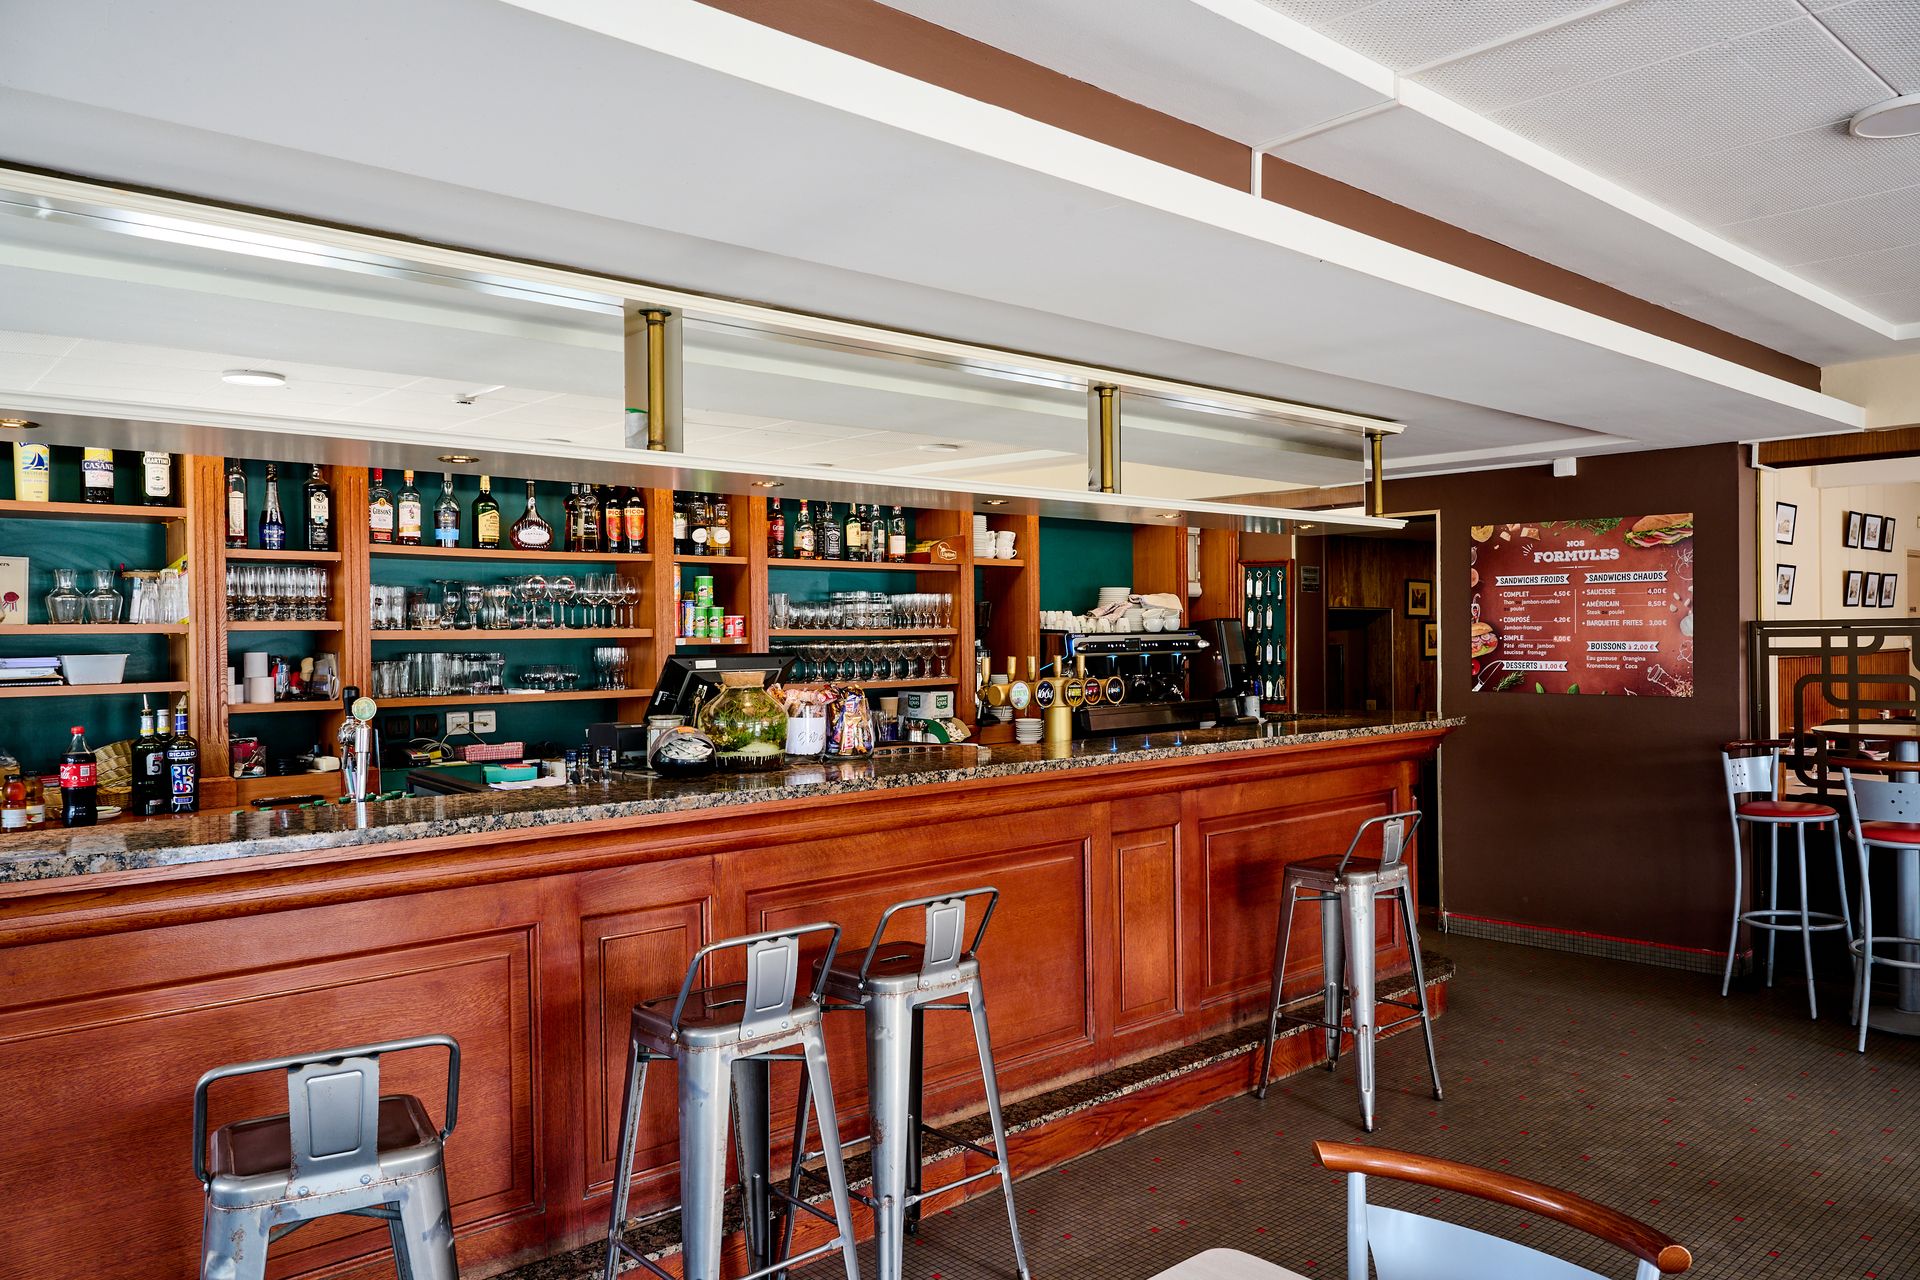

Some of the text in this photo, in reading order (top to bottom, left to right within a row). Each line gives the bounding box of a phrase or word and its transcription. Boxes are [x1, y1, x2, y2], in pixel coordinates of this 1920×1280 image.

[1533, 548, 1620, 563] FORMULES
[1500, 575, 1565, 584] SANDWICHS FROIDS
[1589, 572, 1663, 581] SANDWICHS CHAUDS
[1503, 615, 1531, 623] COMPOSÉ
[1590, 642, 1627, 650] BOISSONS
[1037, 688, 1054, 699] 1664
